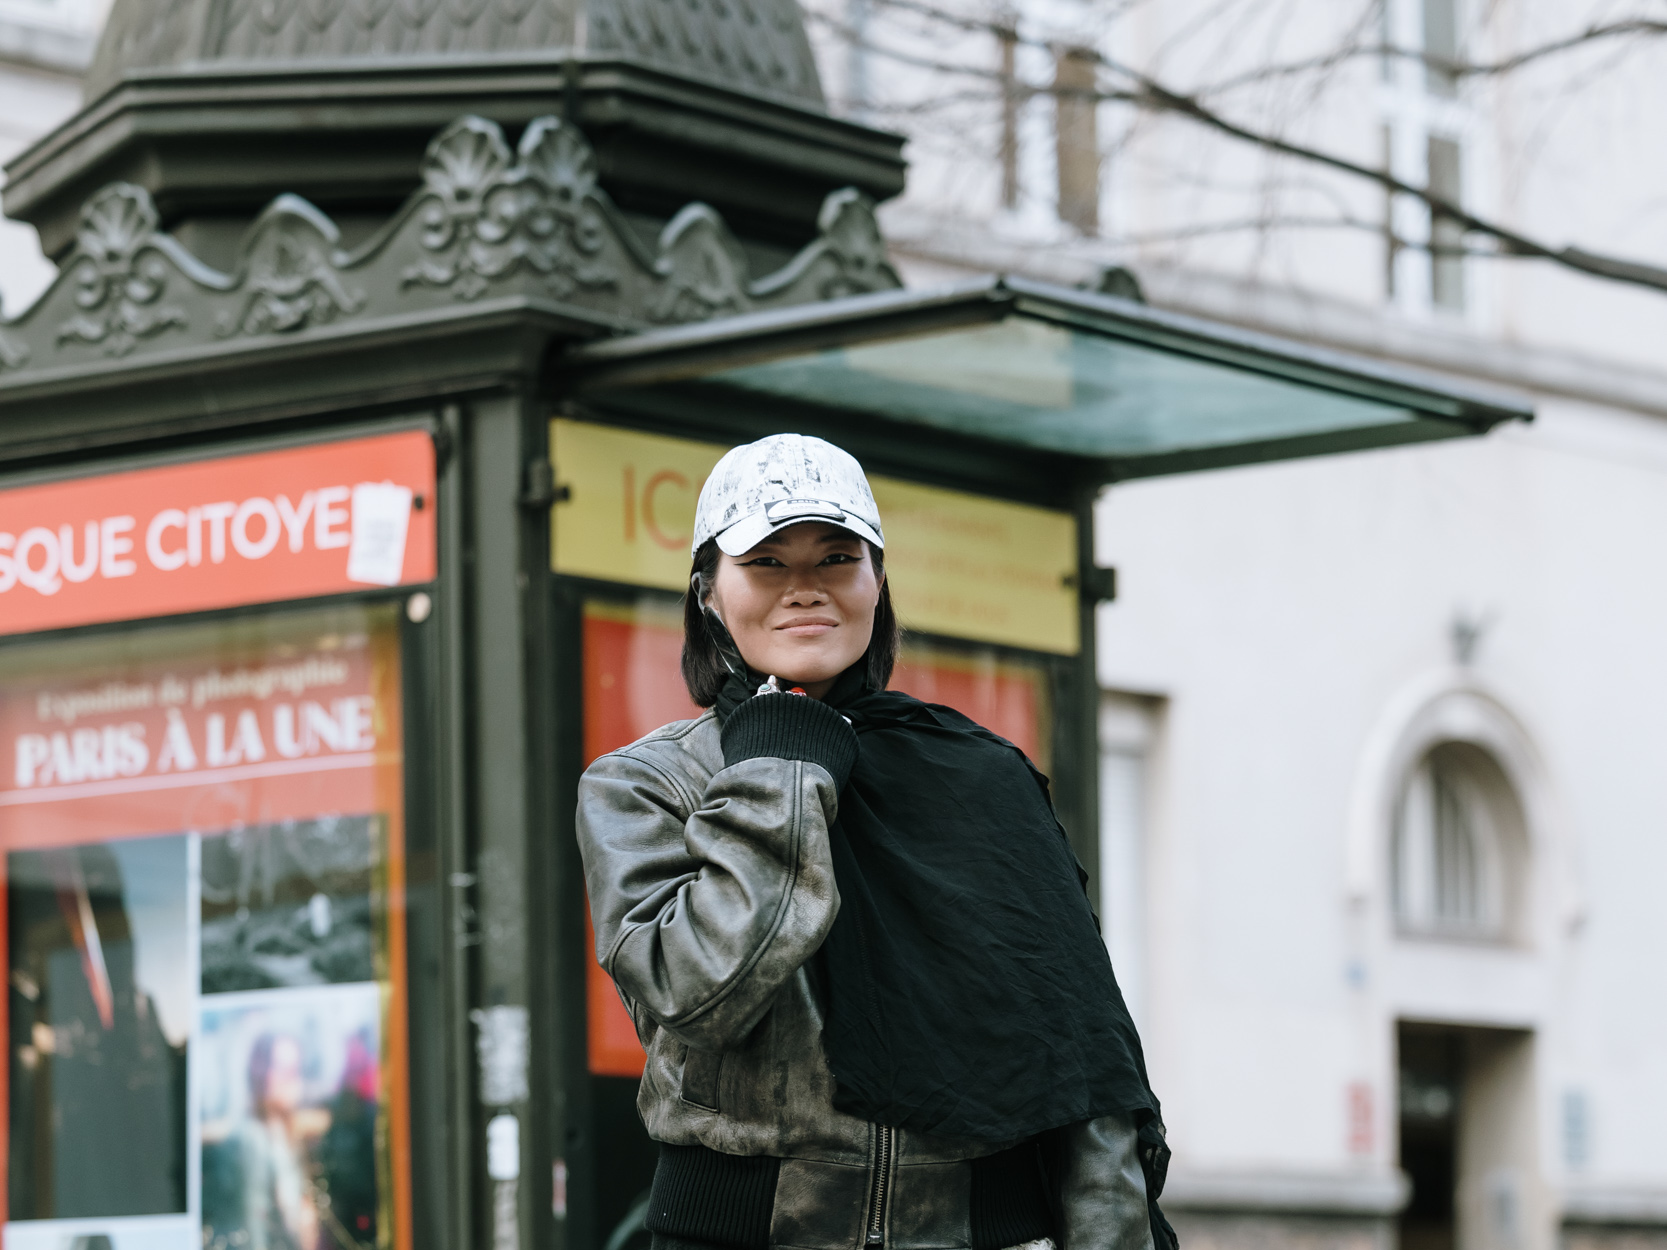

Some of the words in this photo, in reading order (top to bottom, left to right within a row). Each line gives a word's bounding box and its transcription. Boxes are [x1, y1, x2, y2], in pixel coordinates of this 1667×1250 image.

[621, 462, 702, 551] IC
[159, 674, 187, 704] de
[194, 655, 347, 706] photographie
[15, 721, 149, 788] PARIS
[158, 706, 196, 773] À
[205, 706, 266, 767] LA
[273, 695, 376, 759] UNE
